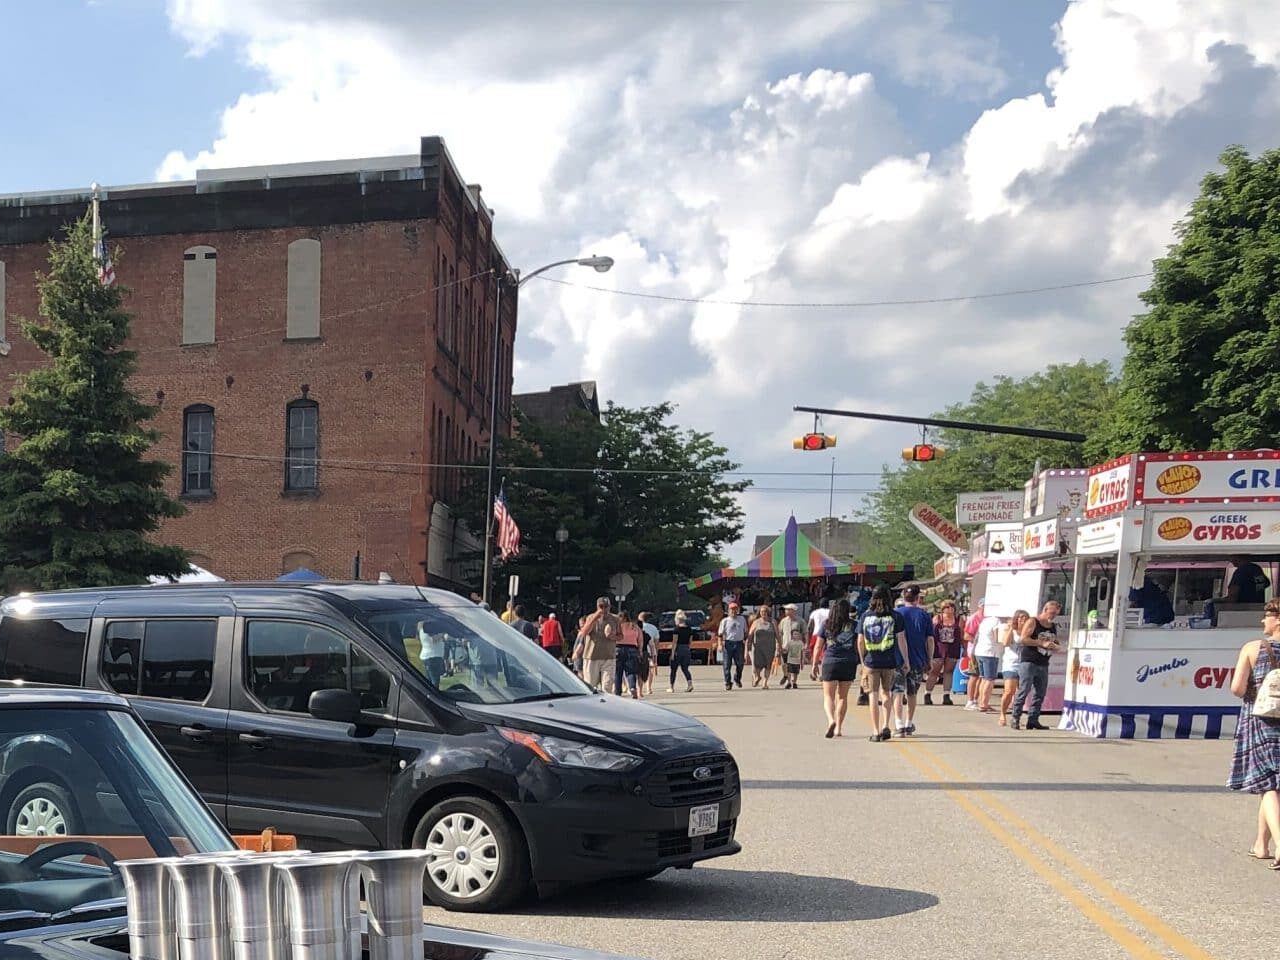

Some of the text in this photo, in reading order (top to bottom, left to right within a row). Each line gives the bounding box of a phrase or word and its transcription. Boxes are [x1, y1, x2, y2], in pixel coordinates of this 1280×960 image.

[1228, 469, 1280, 489] GR
[1100, 478, 1126, 503] GYROS
[961, 500, 1021, 511] FRENCH FRIES
[918, 508, 962, 543] CORN DOGS
[968, 511, 1014, 521] LEMONADE
[1210, 515, 1248, 524] GREEK
[1193, 524, 1262, 541] GYROS
[1136, 656, 1190, 683] Jumbo
[1193, 667, 1236, 689] GY
